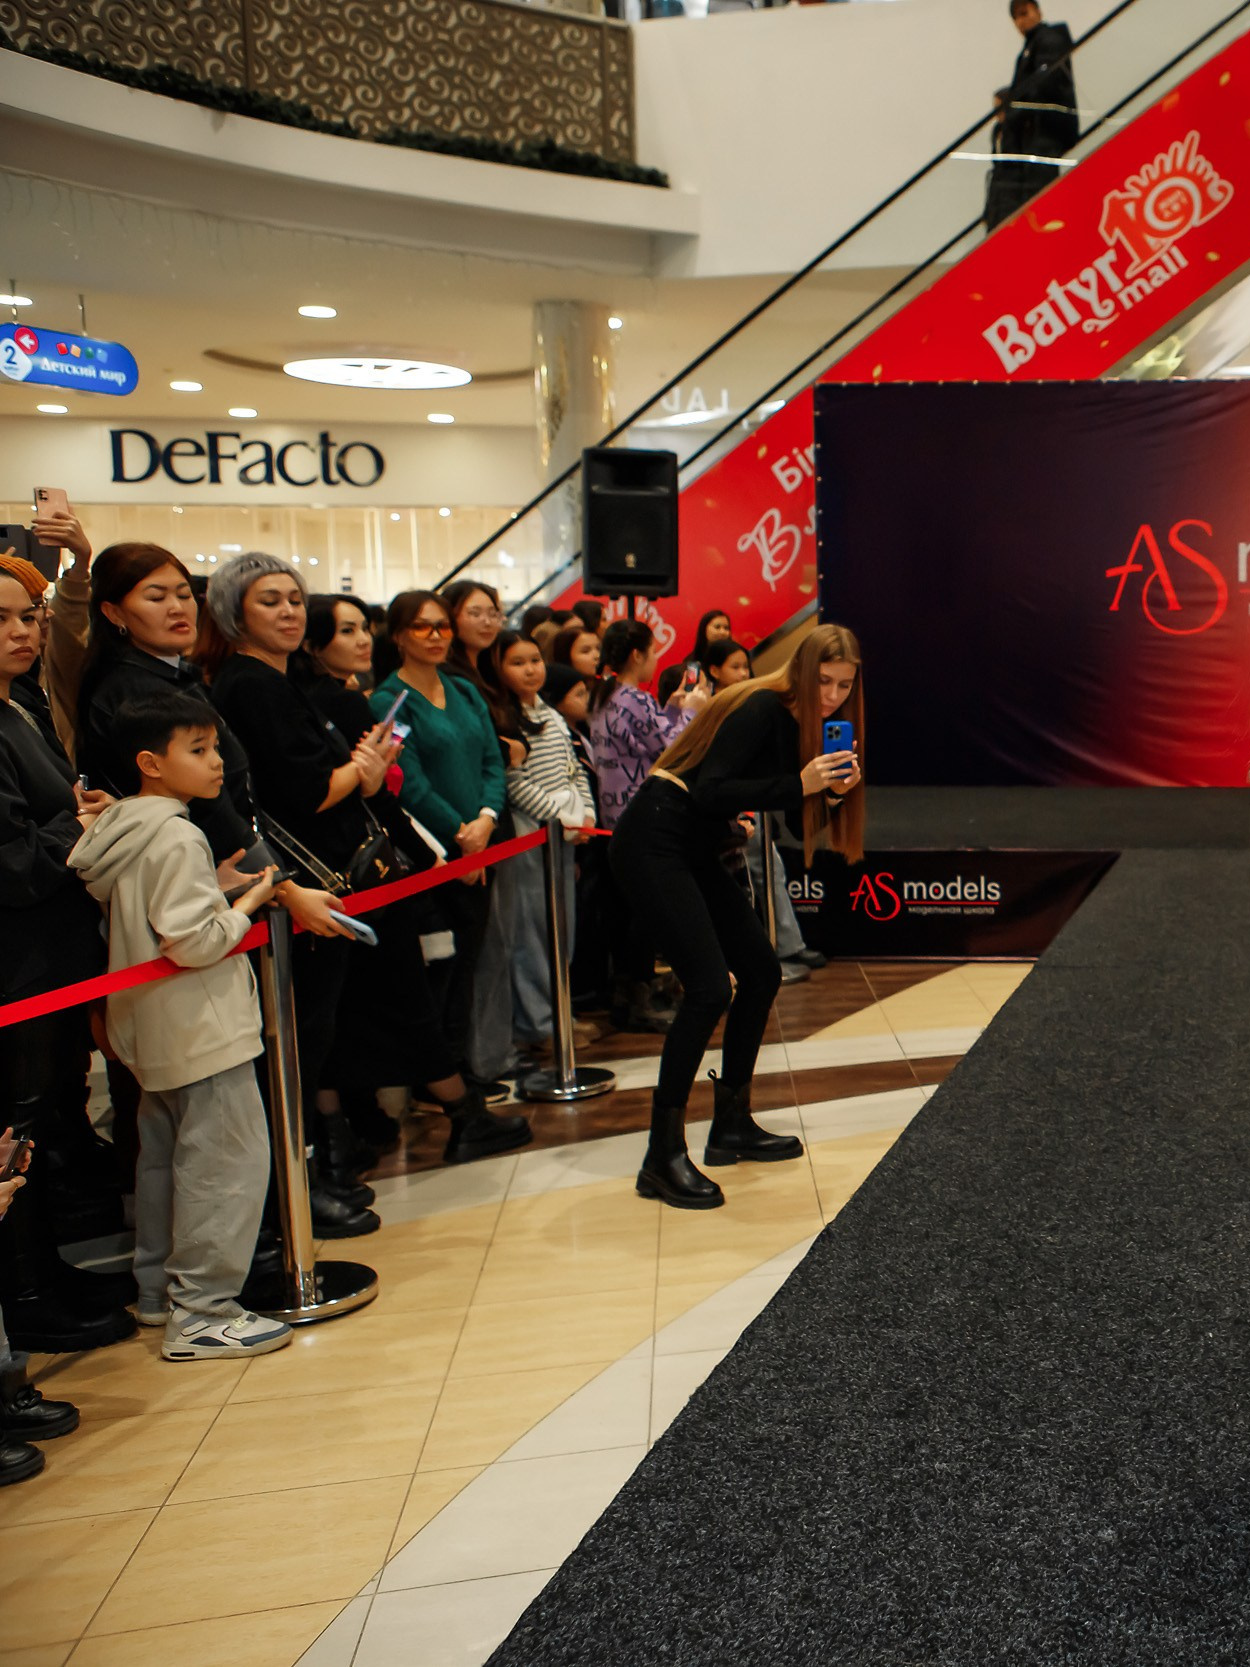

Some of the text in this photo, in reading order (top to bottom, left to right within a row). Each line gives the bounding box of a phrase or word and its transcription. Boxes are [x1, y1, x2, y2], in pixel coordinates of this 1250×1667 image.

[1116, 245, 1190, 311] mall
[982, 248, 1124, 375] Batyr
[4, 345, 18, 365] 2
[40, 357, 98, 379] Детский
[99, 369, 127, 387] мир
[109, 428, 385, 488] DeFacto
[1105, 518, 1229, 636] AS
[850, 872, 1001, 921] AS models
